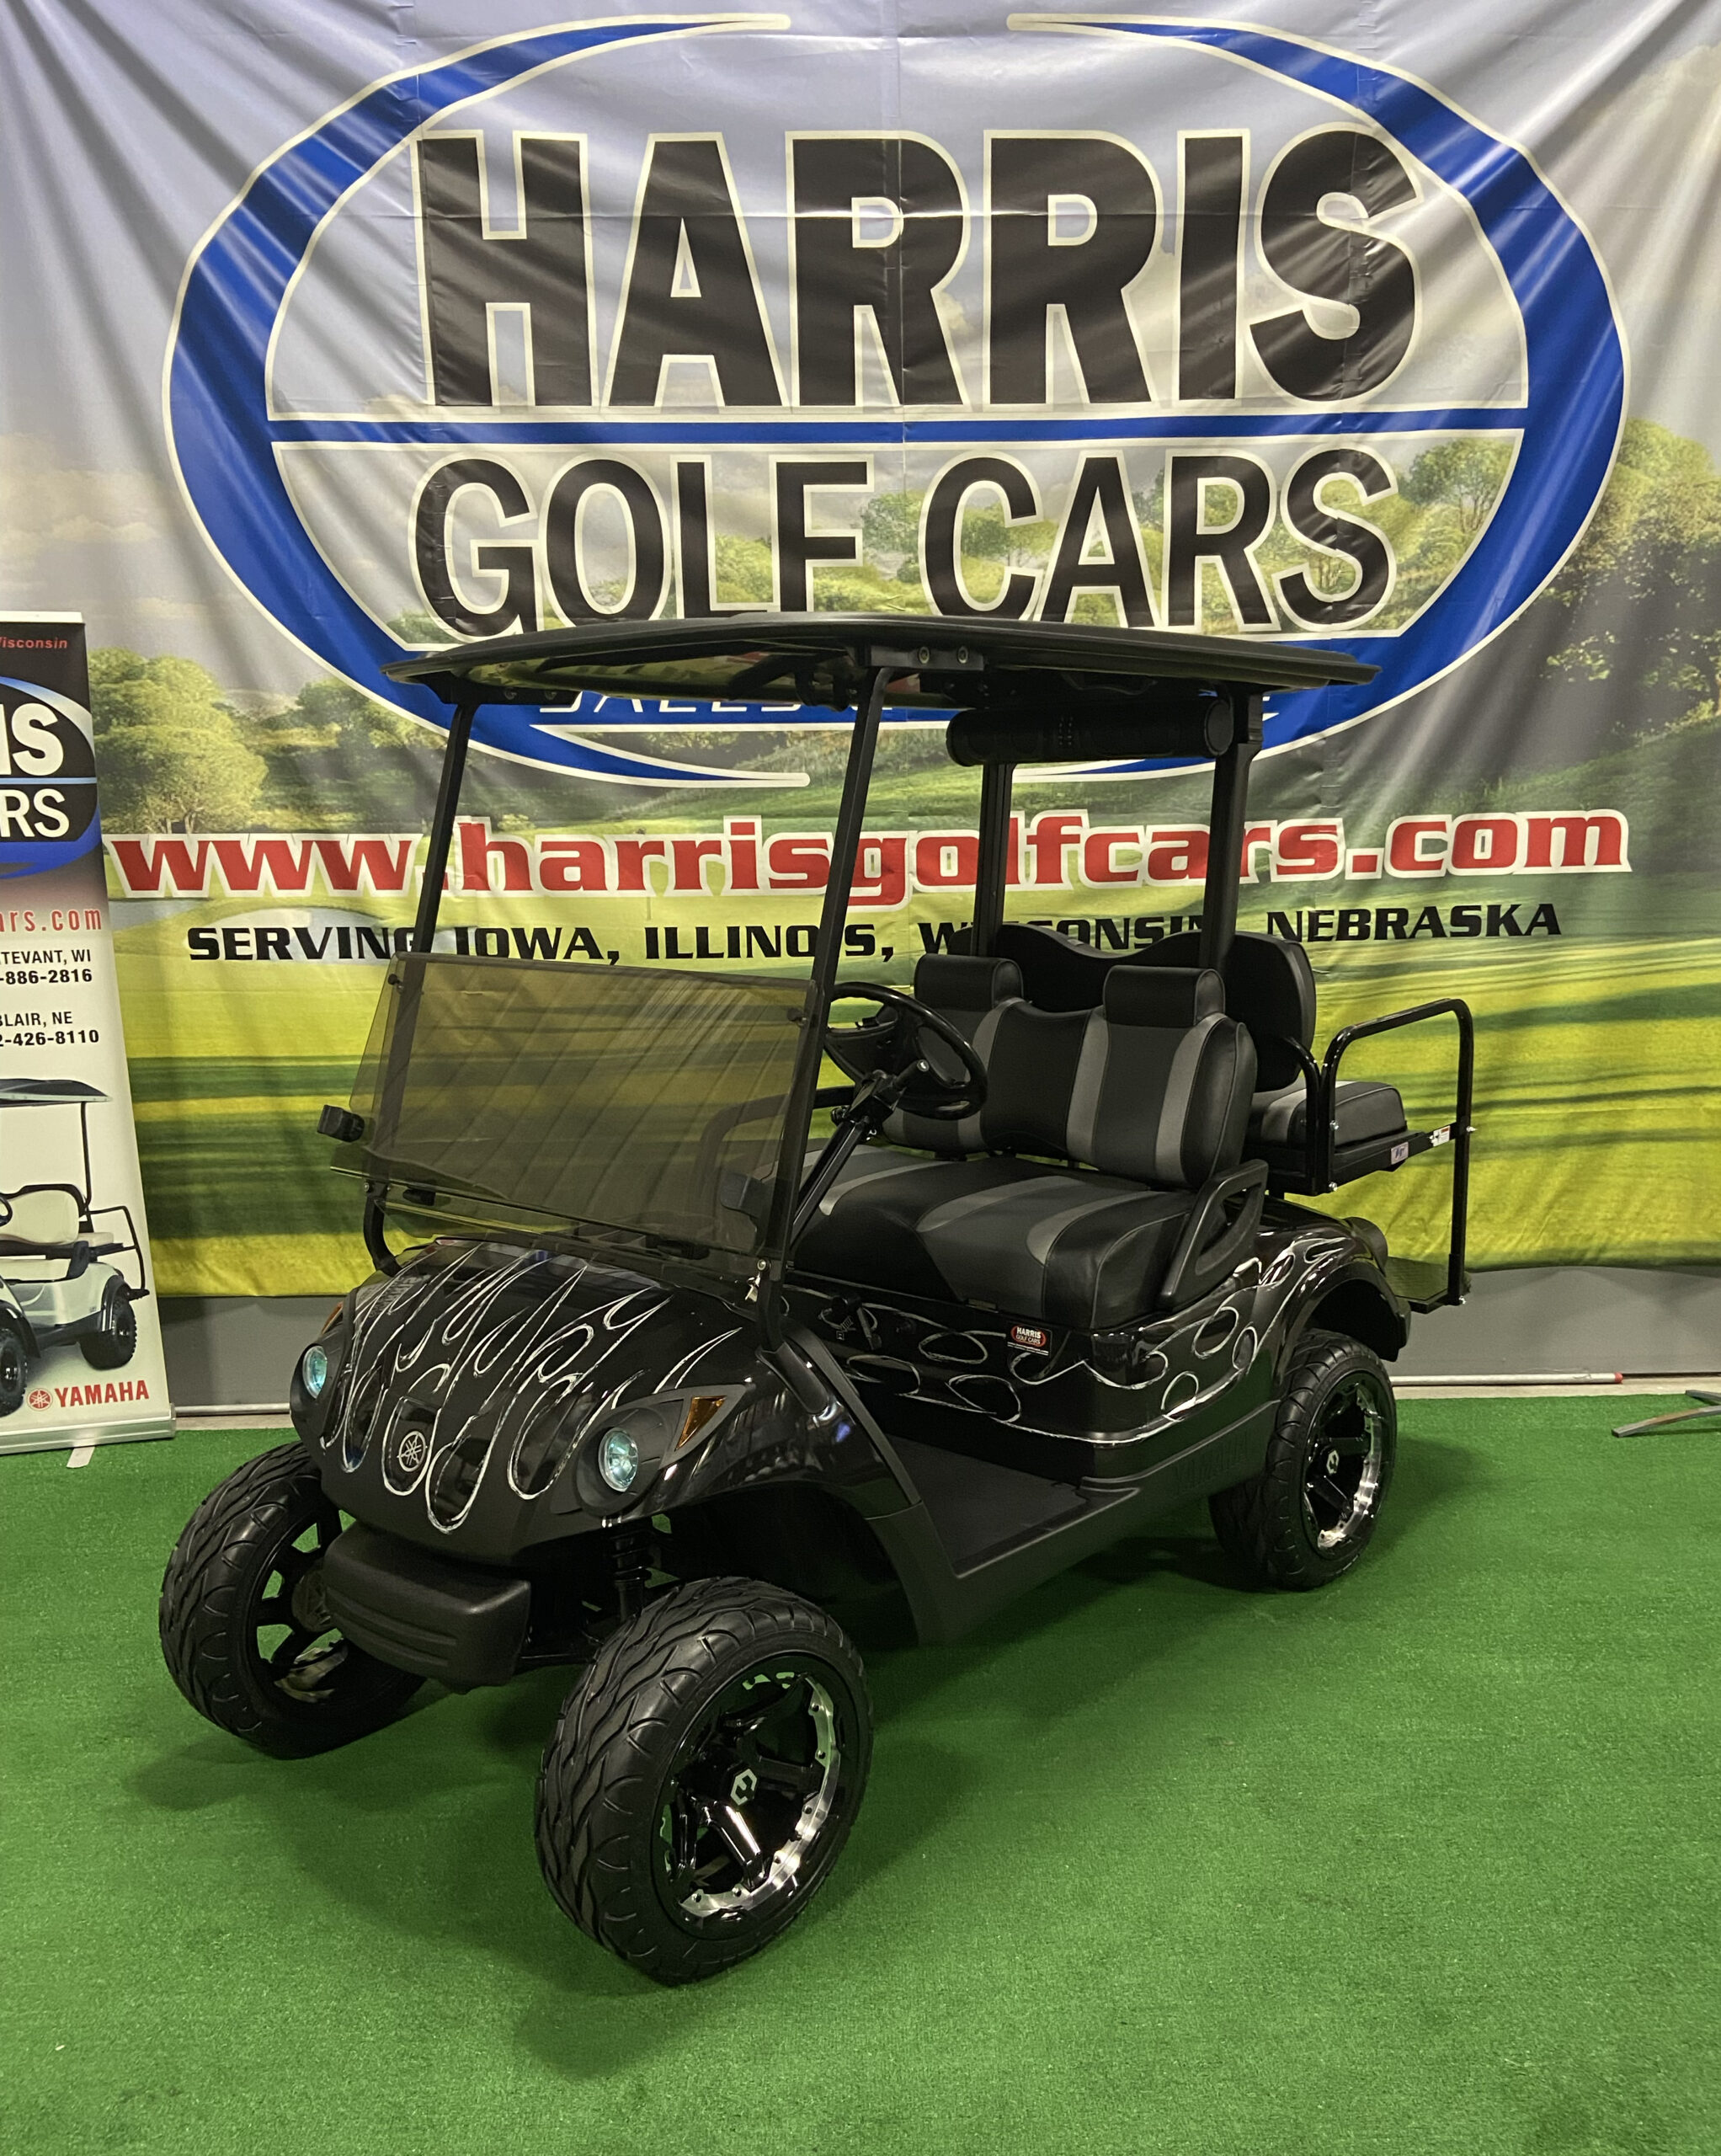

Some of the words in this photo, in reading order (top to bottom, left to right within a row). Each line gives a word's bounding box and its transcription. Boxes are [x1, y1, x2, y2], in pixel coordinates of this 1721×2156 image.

[423, 131, 1418, 408] HARRIS
[415, 457, 869, 638] GOLF
[924, 451, 1397, 631] CARS
[0, 637, 67, 648] isconsin
[0, 788, 70, 838] RS
[109, 814, 1628, 907] wwwharrisgofcars.com
[455, 926, 620, 966] IOWA,
[644, 924, 894, 963] ILLINOS,
[1266, 903, 1562, 942] NEBRASKA
[72, 949, 91, 963] WI
[52, 1011, 73, 1025] NE
[1016, 1326, 1042, 1339] HARRIS
[1027, 1337, 1041, 1345] CARS
[54, 1380, 150, 1408] YAMAHA
